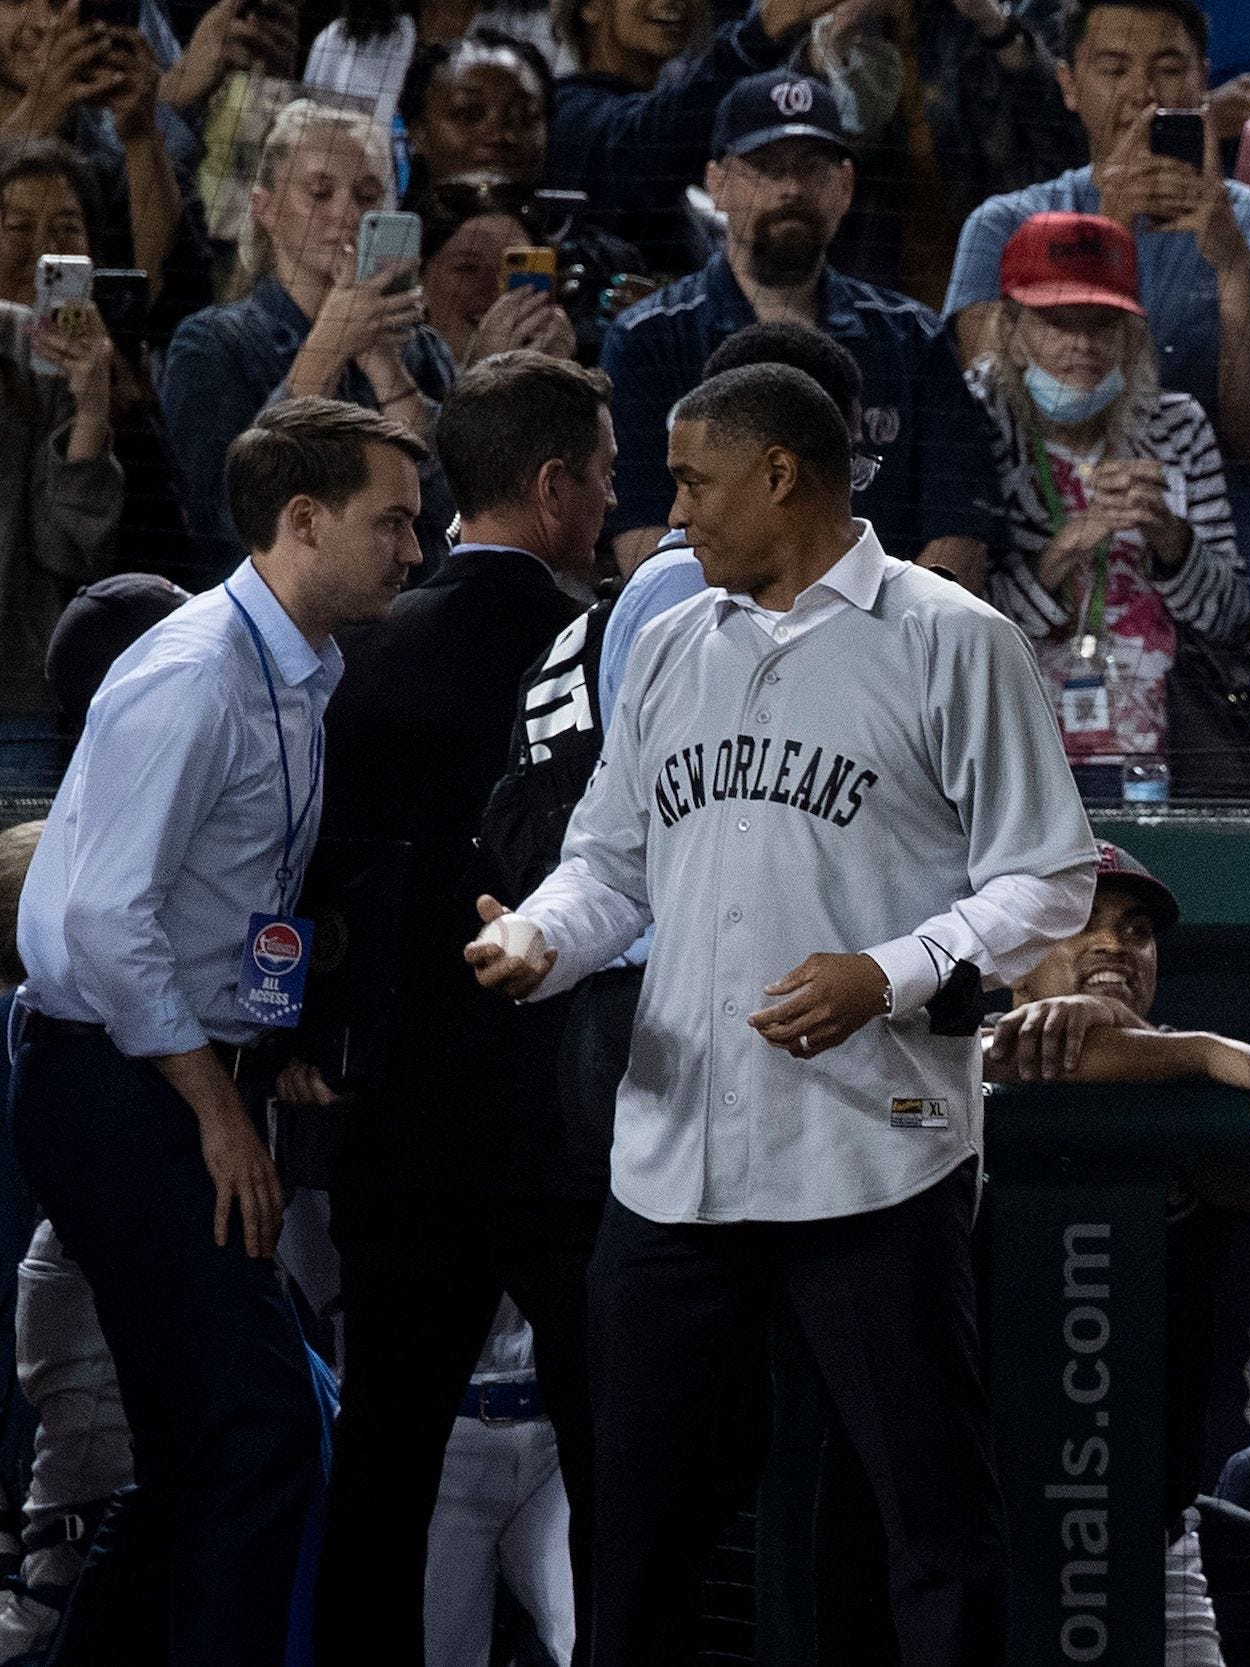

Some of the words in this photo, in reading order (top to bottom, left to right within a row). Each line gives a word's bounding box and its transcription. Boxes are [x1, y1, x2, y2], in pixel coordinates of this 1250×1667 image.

[655, 743, 706, 828] NEW
[712, 735, 878, 827] ORLEANS
[261, 976, 280, 991] ALL
[248, 988, 290, 1006] ACCESS
[929, 1101, 944, 1117] XL
